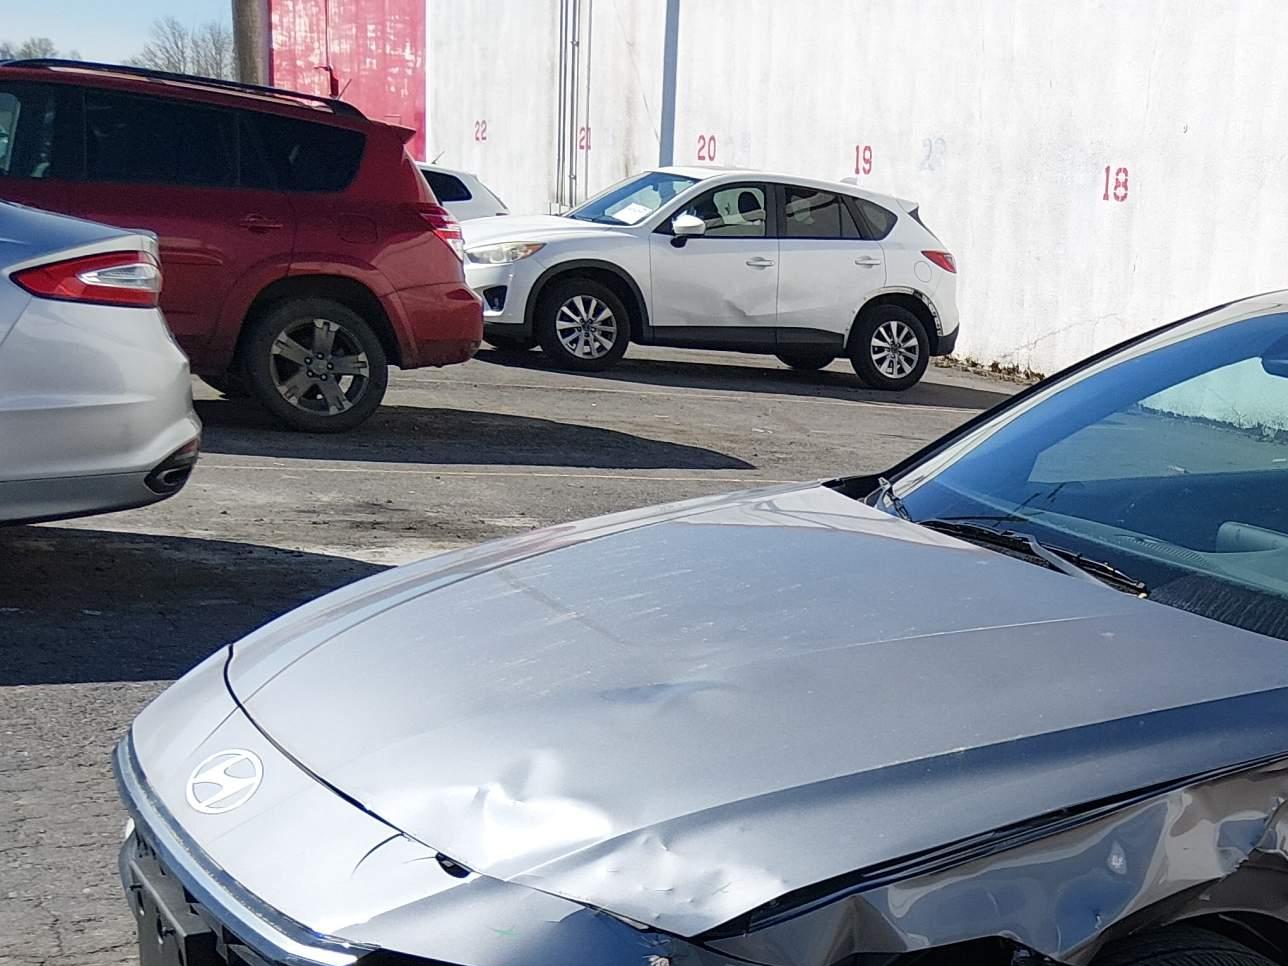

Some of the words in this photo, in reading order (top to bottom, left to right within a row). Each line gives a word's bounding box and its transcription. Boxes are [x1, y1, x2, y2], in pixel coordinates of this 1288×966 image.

[474, 120, 487, 141] 22
[697, 134, 716, 161] 20
[854, 144, 873, 175] 19
[1102, 165, 1129, 202] 18
